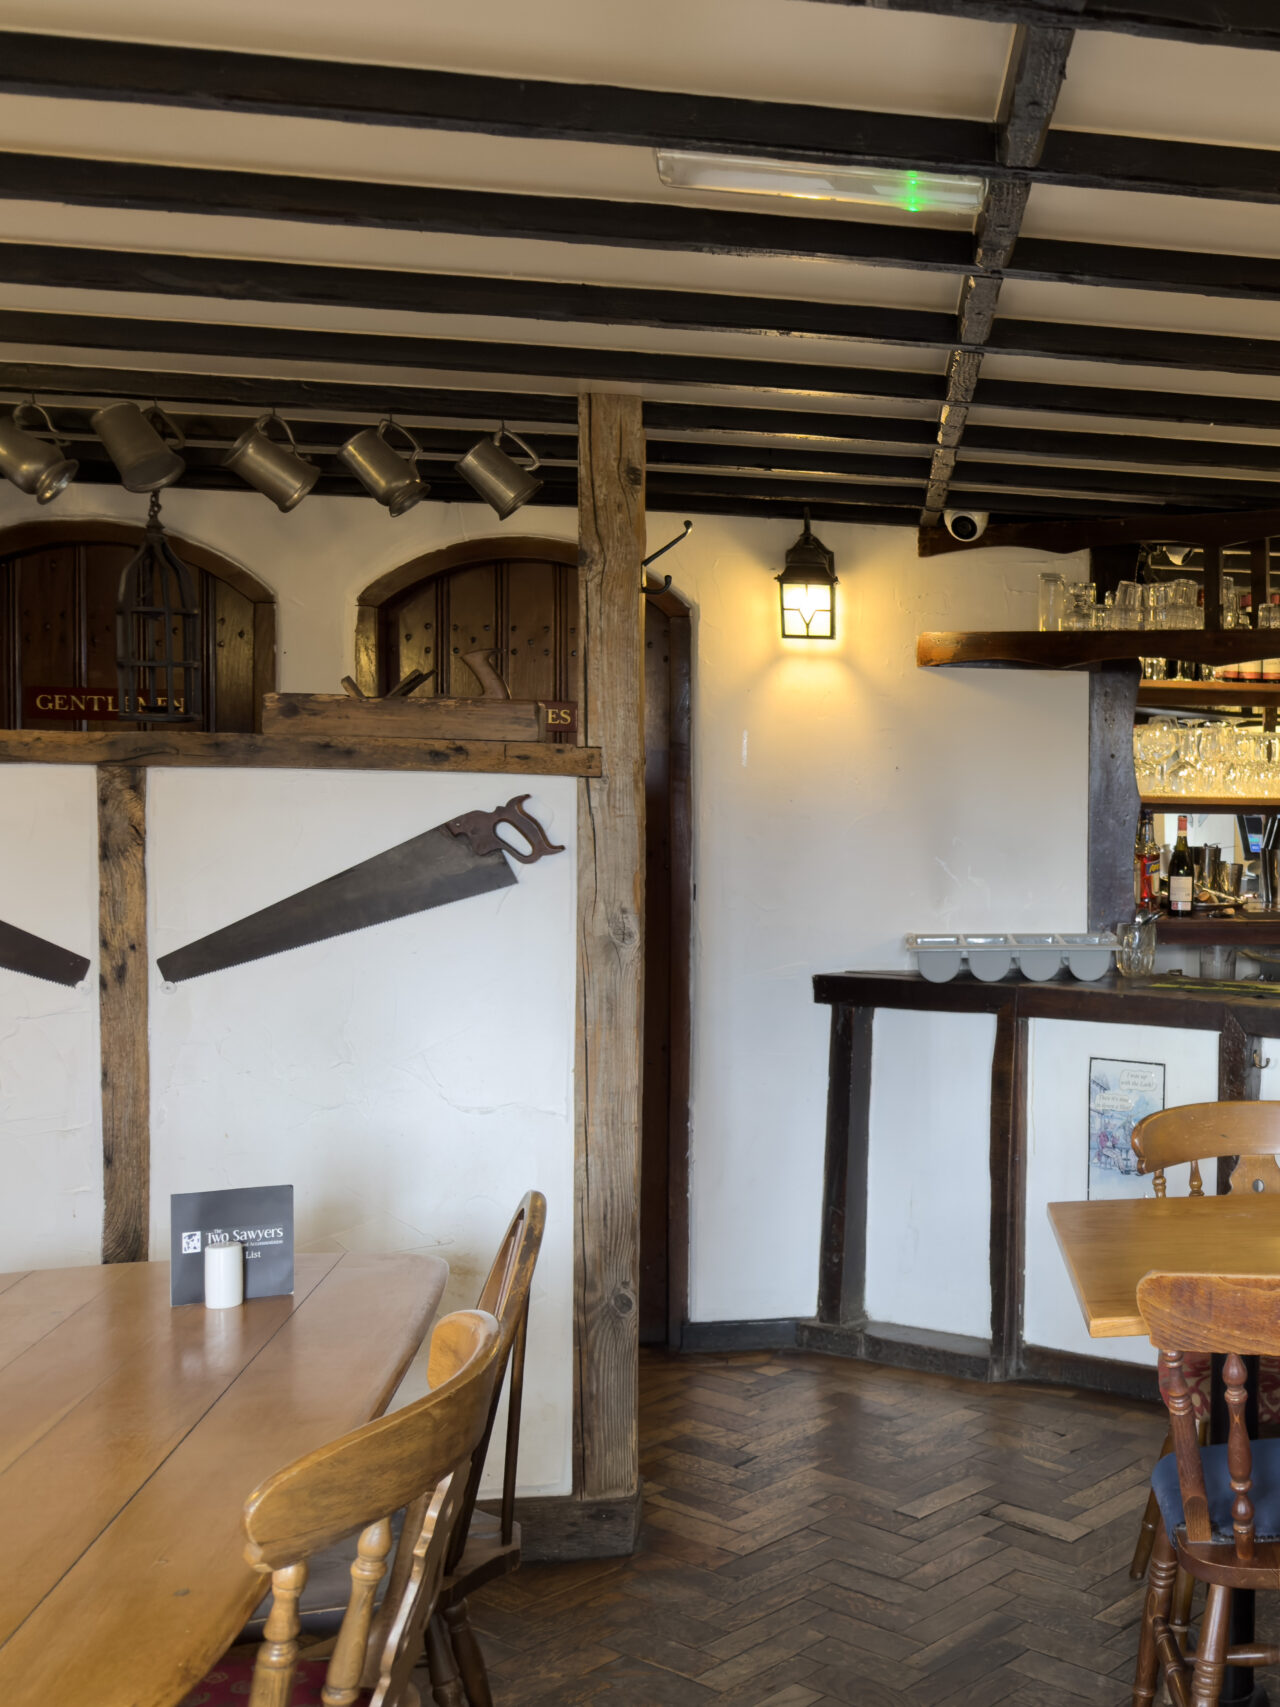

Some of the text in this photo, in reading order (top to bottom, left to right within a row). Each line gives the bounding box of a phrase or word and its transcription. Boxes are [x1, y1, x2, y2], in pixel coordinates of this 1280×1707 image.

[36, 694, 185, 713] GENTLMEN
[206, 1227, 284, 1244] Two Sawyers
[246, 1251, 262, 1259] List
